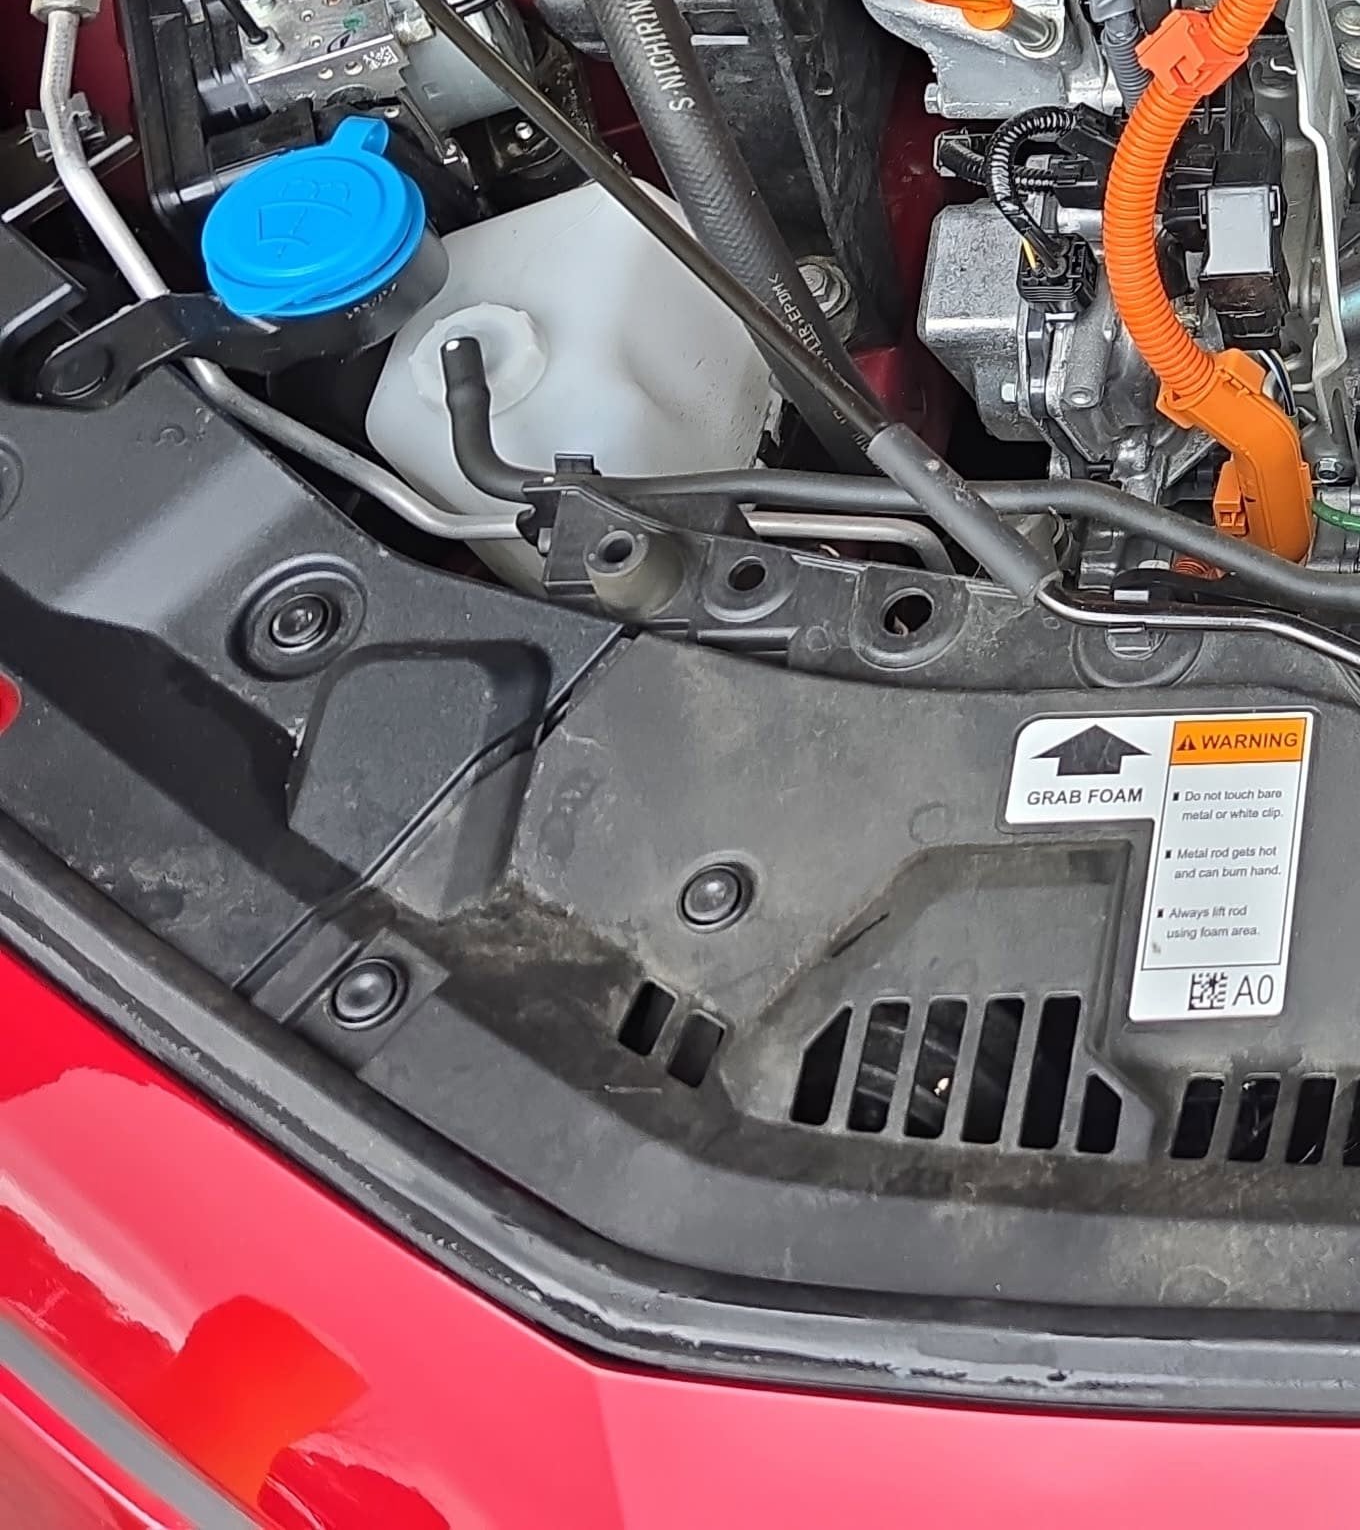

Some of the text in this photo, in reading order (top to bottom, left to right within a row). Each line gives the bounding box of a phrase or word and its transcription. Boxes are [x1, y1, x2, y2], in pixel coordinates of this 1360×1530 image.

[1201, 732, 1299, 750] WARNING
[1027, 787, 1143, 806] GRAB FOAM
[1185, 789, 1282, 802] Do not touch bare
[1182, 808, 1284, 821] metal or white clip.
[1177, 846, 1277, 860] Metal rod gets hot
[1174, 869, 1196, 879] and
[1198, 869, 1220, 878] can
[1250, 865, 1282, 876] hand.
[1169, 906, 1248, 920] Always lift rod
[1167, 927, 1260, 940] using foam area.
[1232, 975, 1275, 1007] A0
